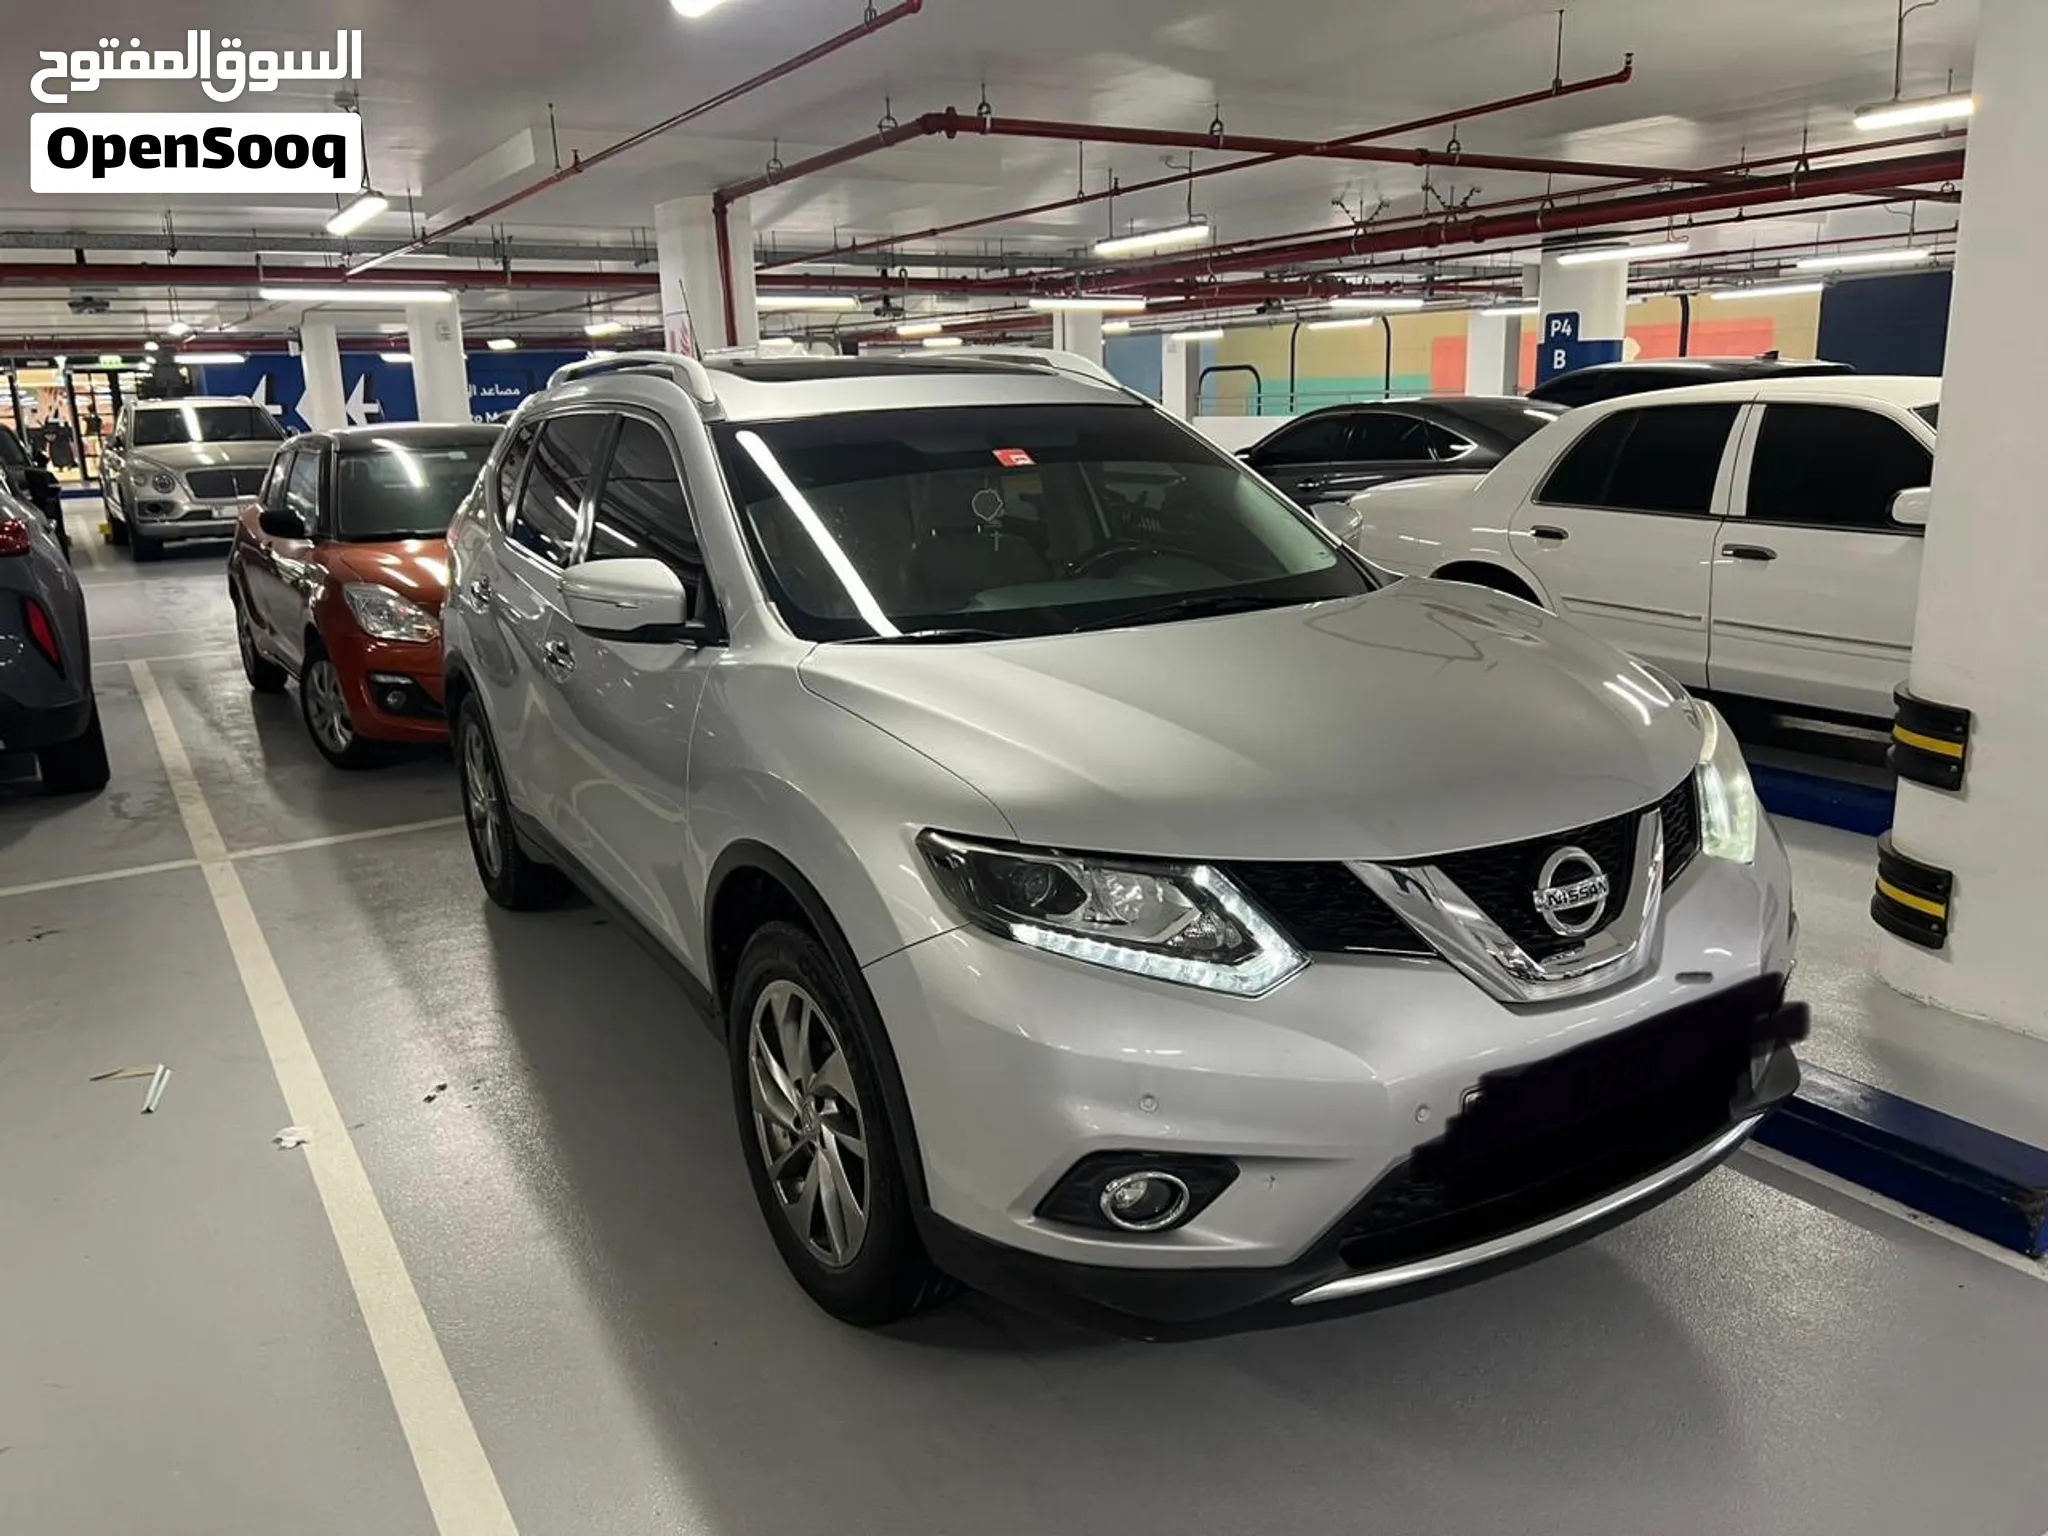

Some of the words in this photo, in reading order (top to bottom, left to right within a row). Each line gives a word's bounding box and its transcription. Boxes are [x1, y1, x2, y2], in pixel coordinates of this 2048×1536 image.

[1551, 319, 1572, 337] P4
[1553, 349, 1566, 369] B
[480, 384, 520, 396] مصاعد
[1547, 880, 1608, 907] NISSAN
